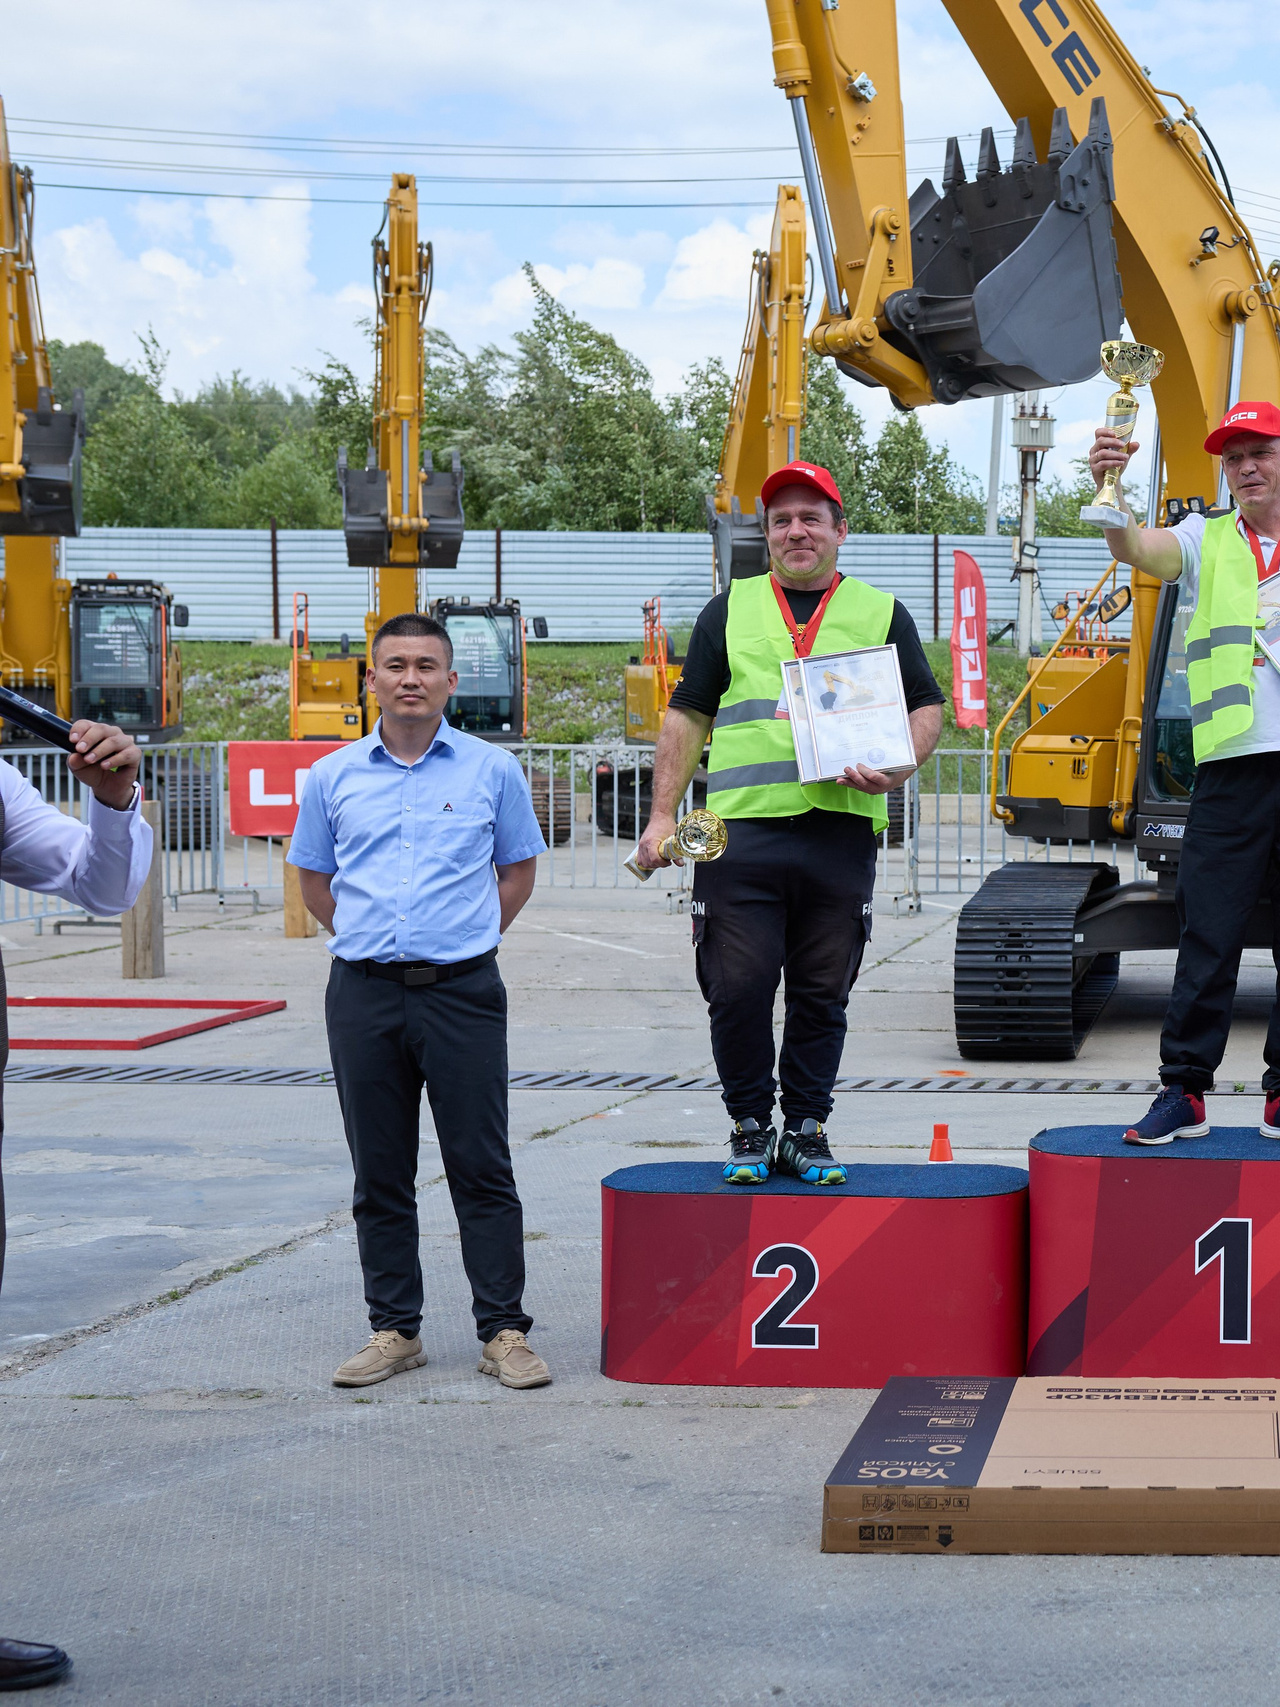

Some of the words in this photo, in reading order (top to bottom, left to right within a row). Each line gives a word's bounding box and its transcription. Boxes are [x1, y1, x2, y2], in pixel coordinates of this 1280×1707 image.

[838, 709, 879, 724] ДИПЛОМ
[752, 1244, 820, 1350] 2
[1195, 1218, 1253, 1346] 1
[856, 1467, 949, 1479] YaOS
